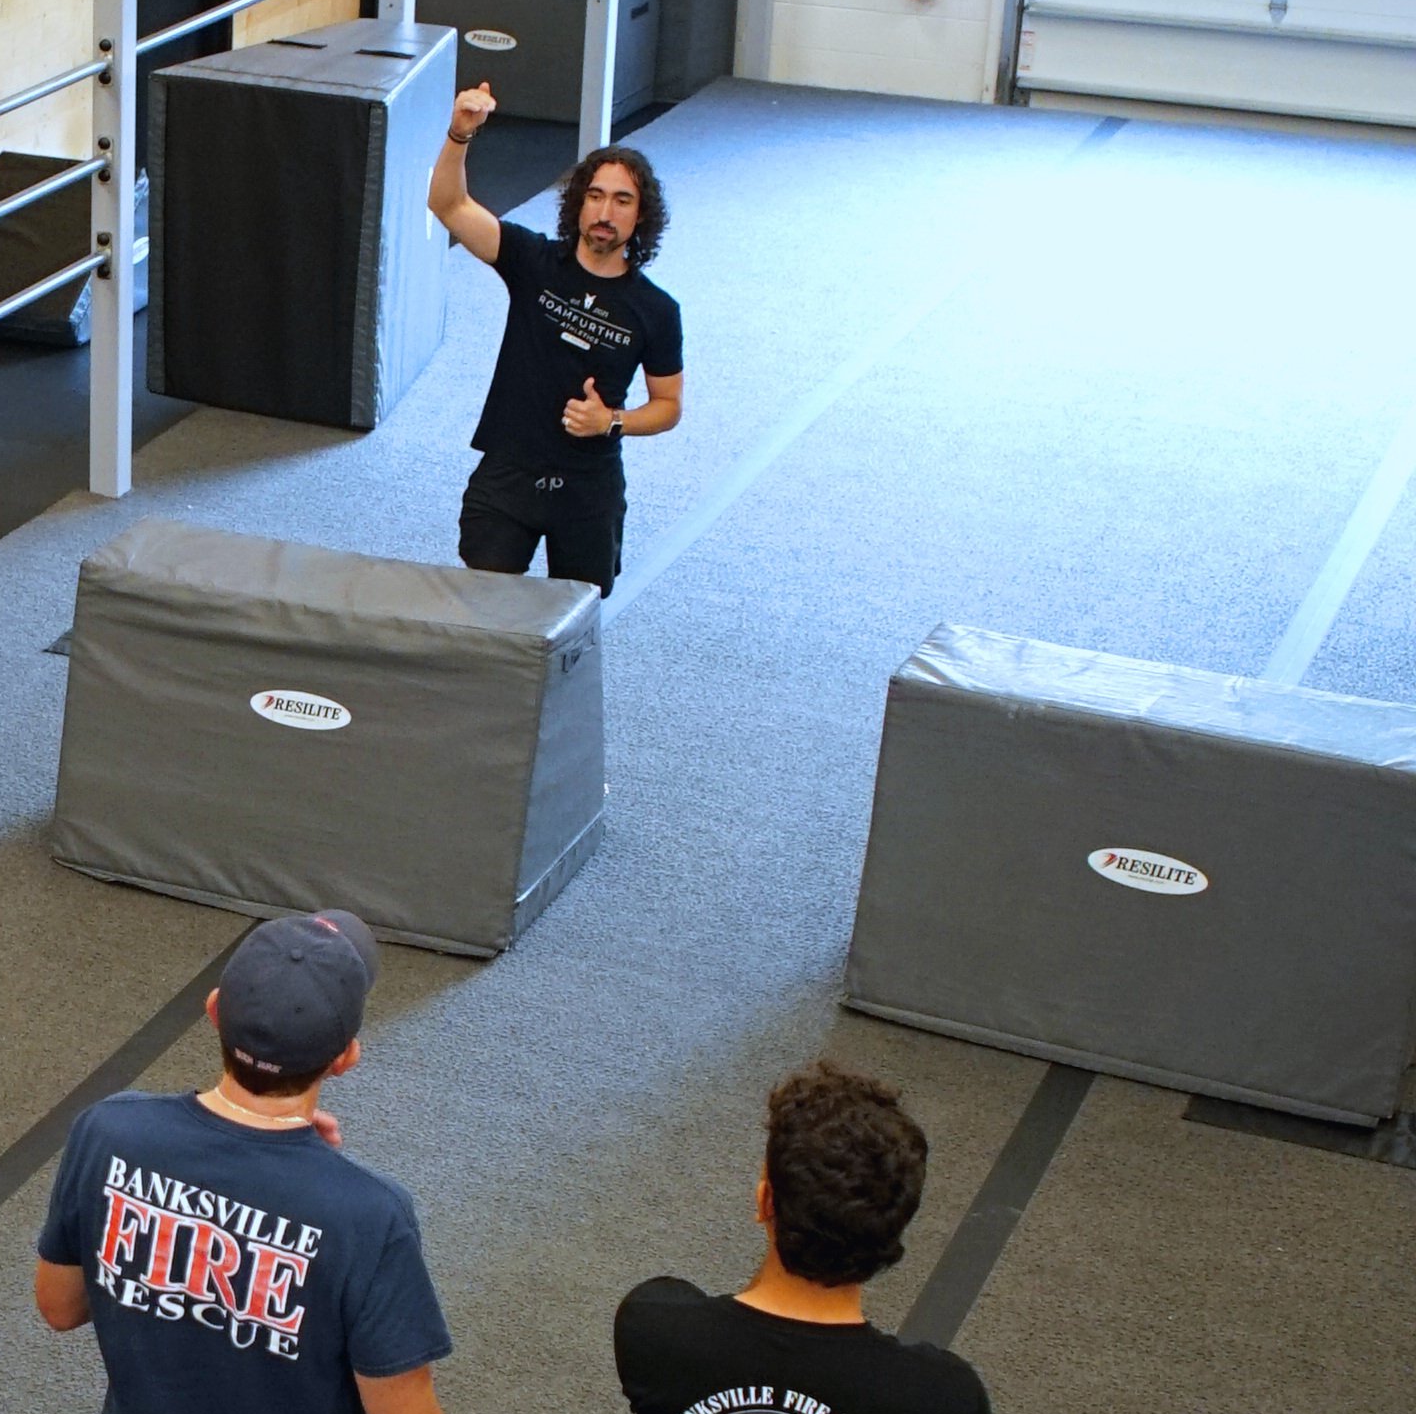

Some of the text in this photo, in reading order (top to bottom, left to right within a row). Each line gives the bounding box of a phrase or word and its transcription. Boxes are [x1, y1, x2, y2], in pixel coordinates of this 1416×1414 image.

[538, 294, 632, 346] ROAMFURTHER
[274, 697, 342, 721] RESILITE
[1116, 856, 1198, 886] RESILITE
[106, 1155, 323, 1258] BANKSVILLE
[96, 1185, 310, 1334] FIRE
[95, 1263, 301, 1361] RESCUE
